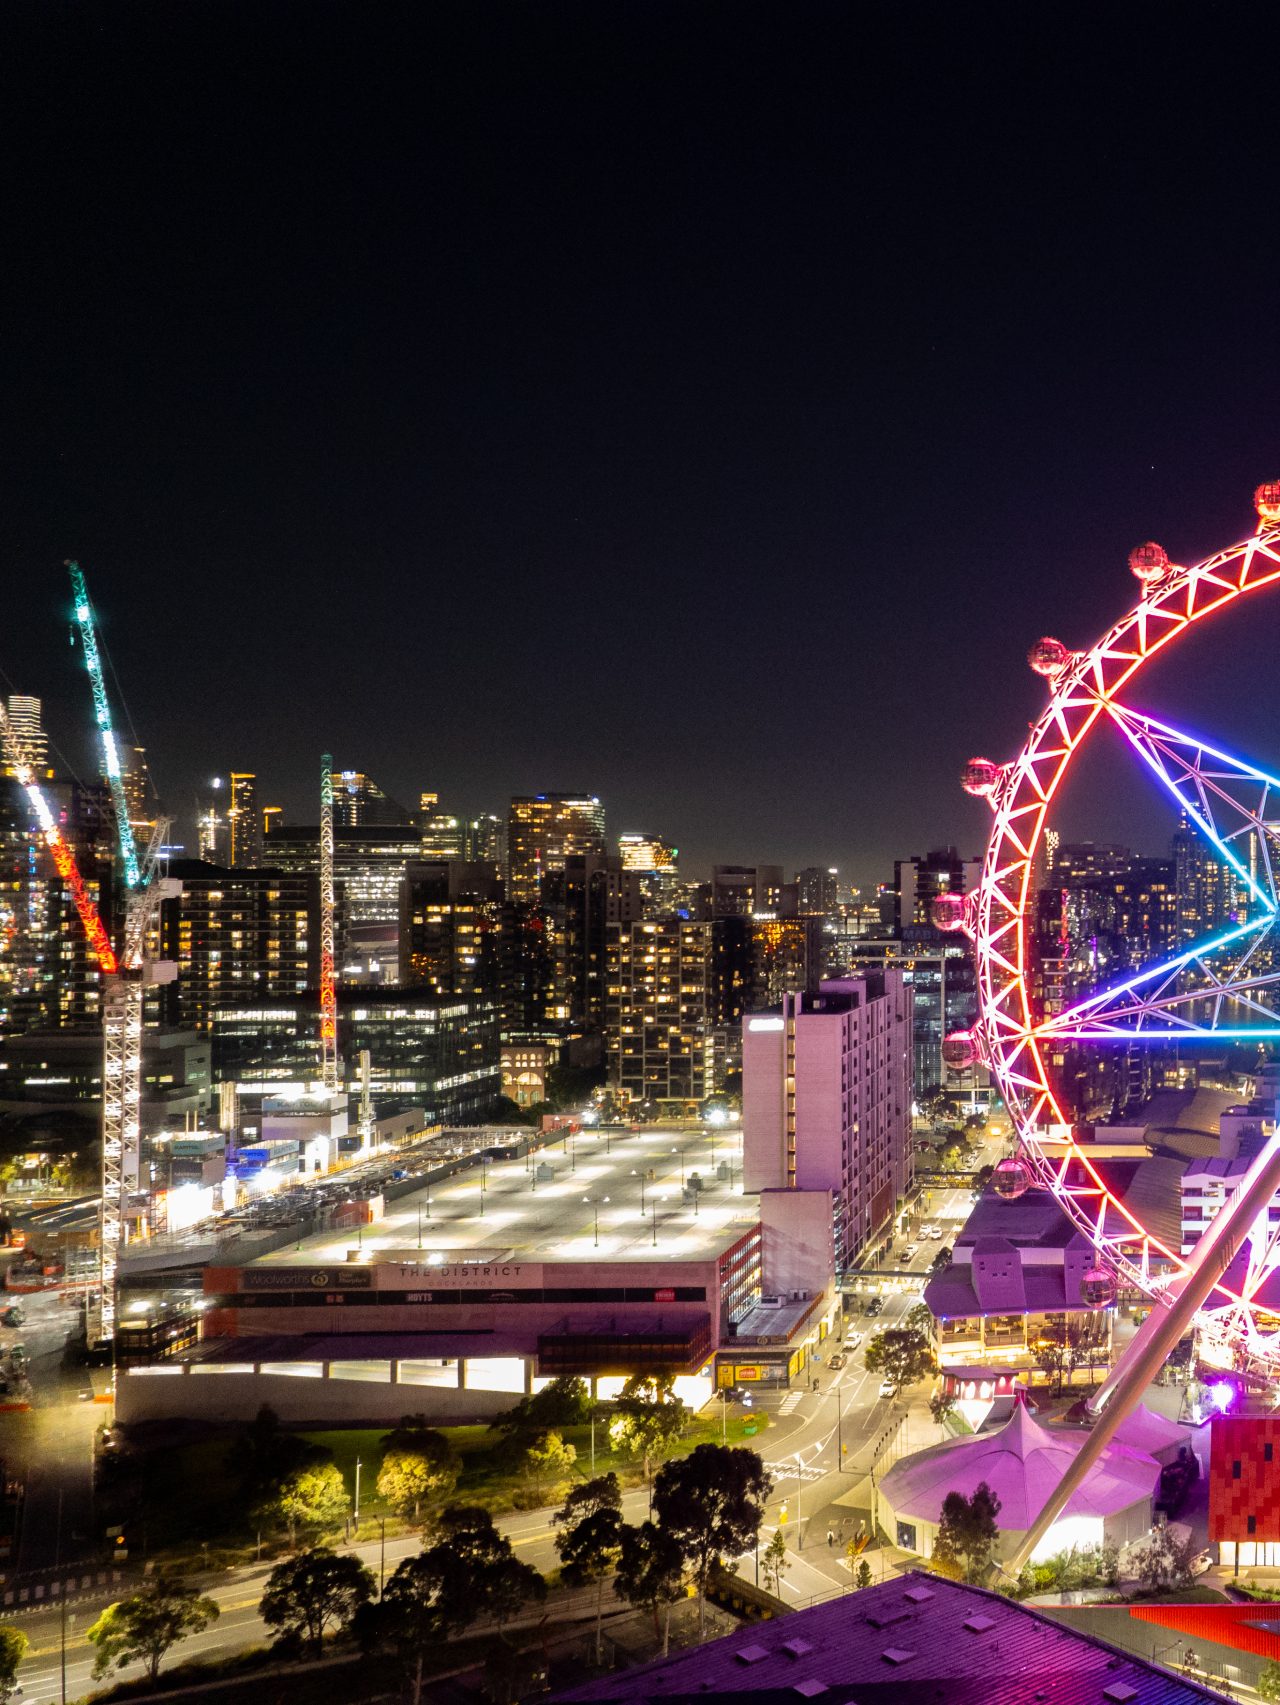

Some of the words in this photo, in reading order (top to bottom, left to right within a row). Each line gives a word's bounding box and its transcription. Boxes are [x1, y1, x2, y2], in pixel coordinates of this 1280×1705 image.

[400, 1268, 431, 1277] THE
[441, 1266, 521, 1277] DISTRICT
[408, 1293, 433, 1302] HOYTS
